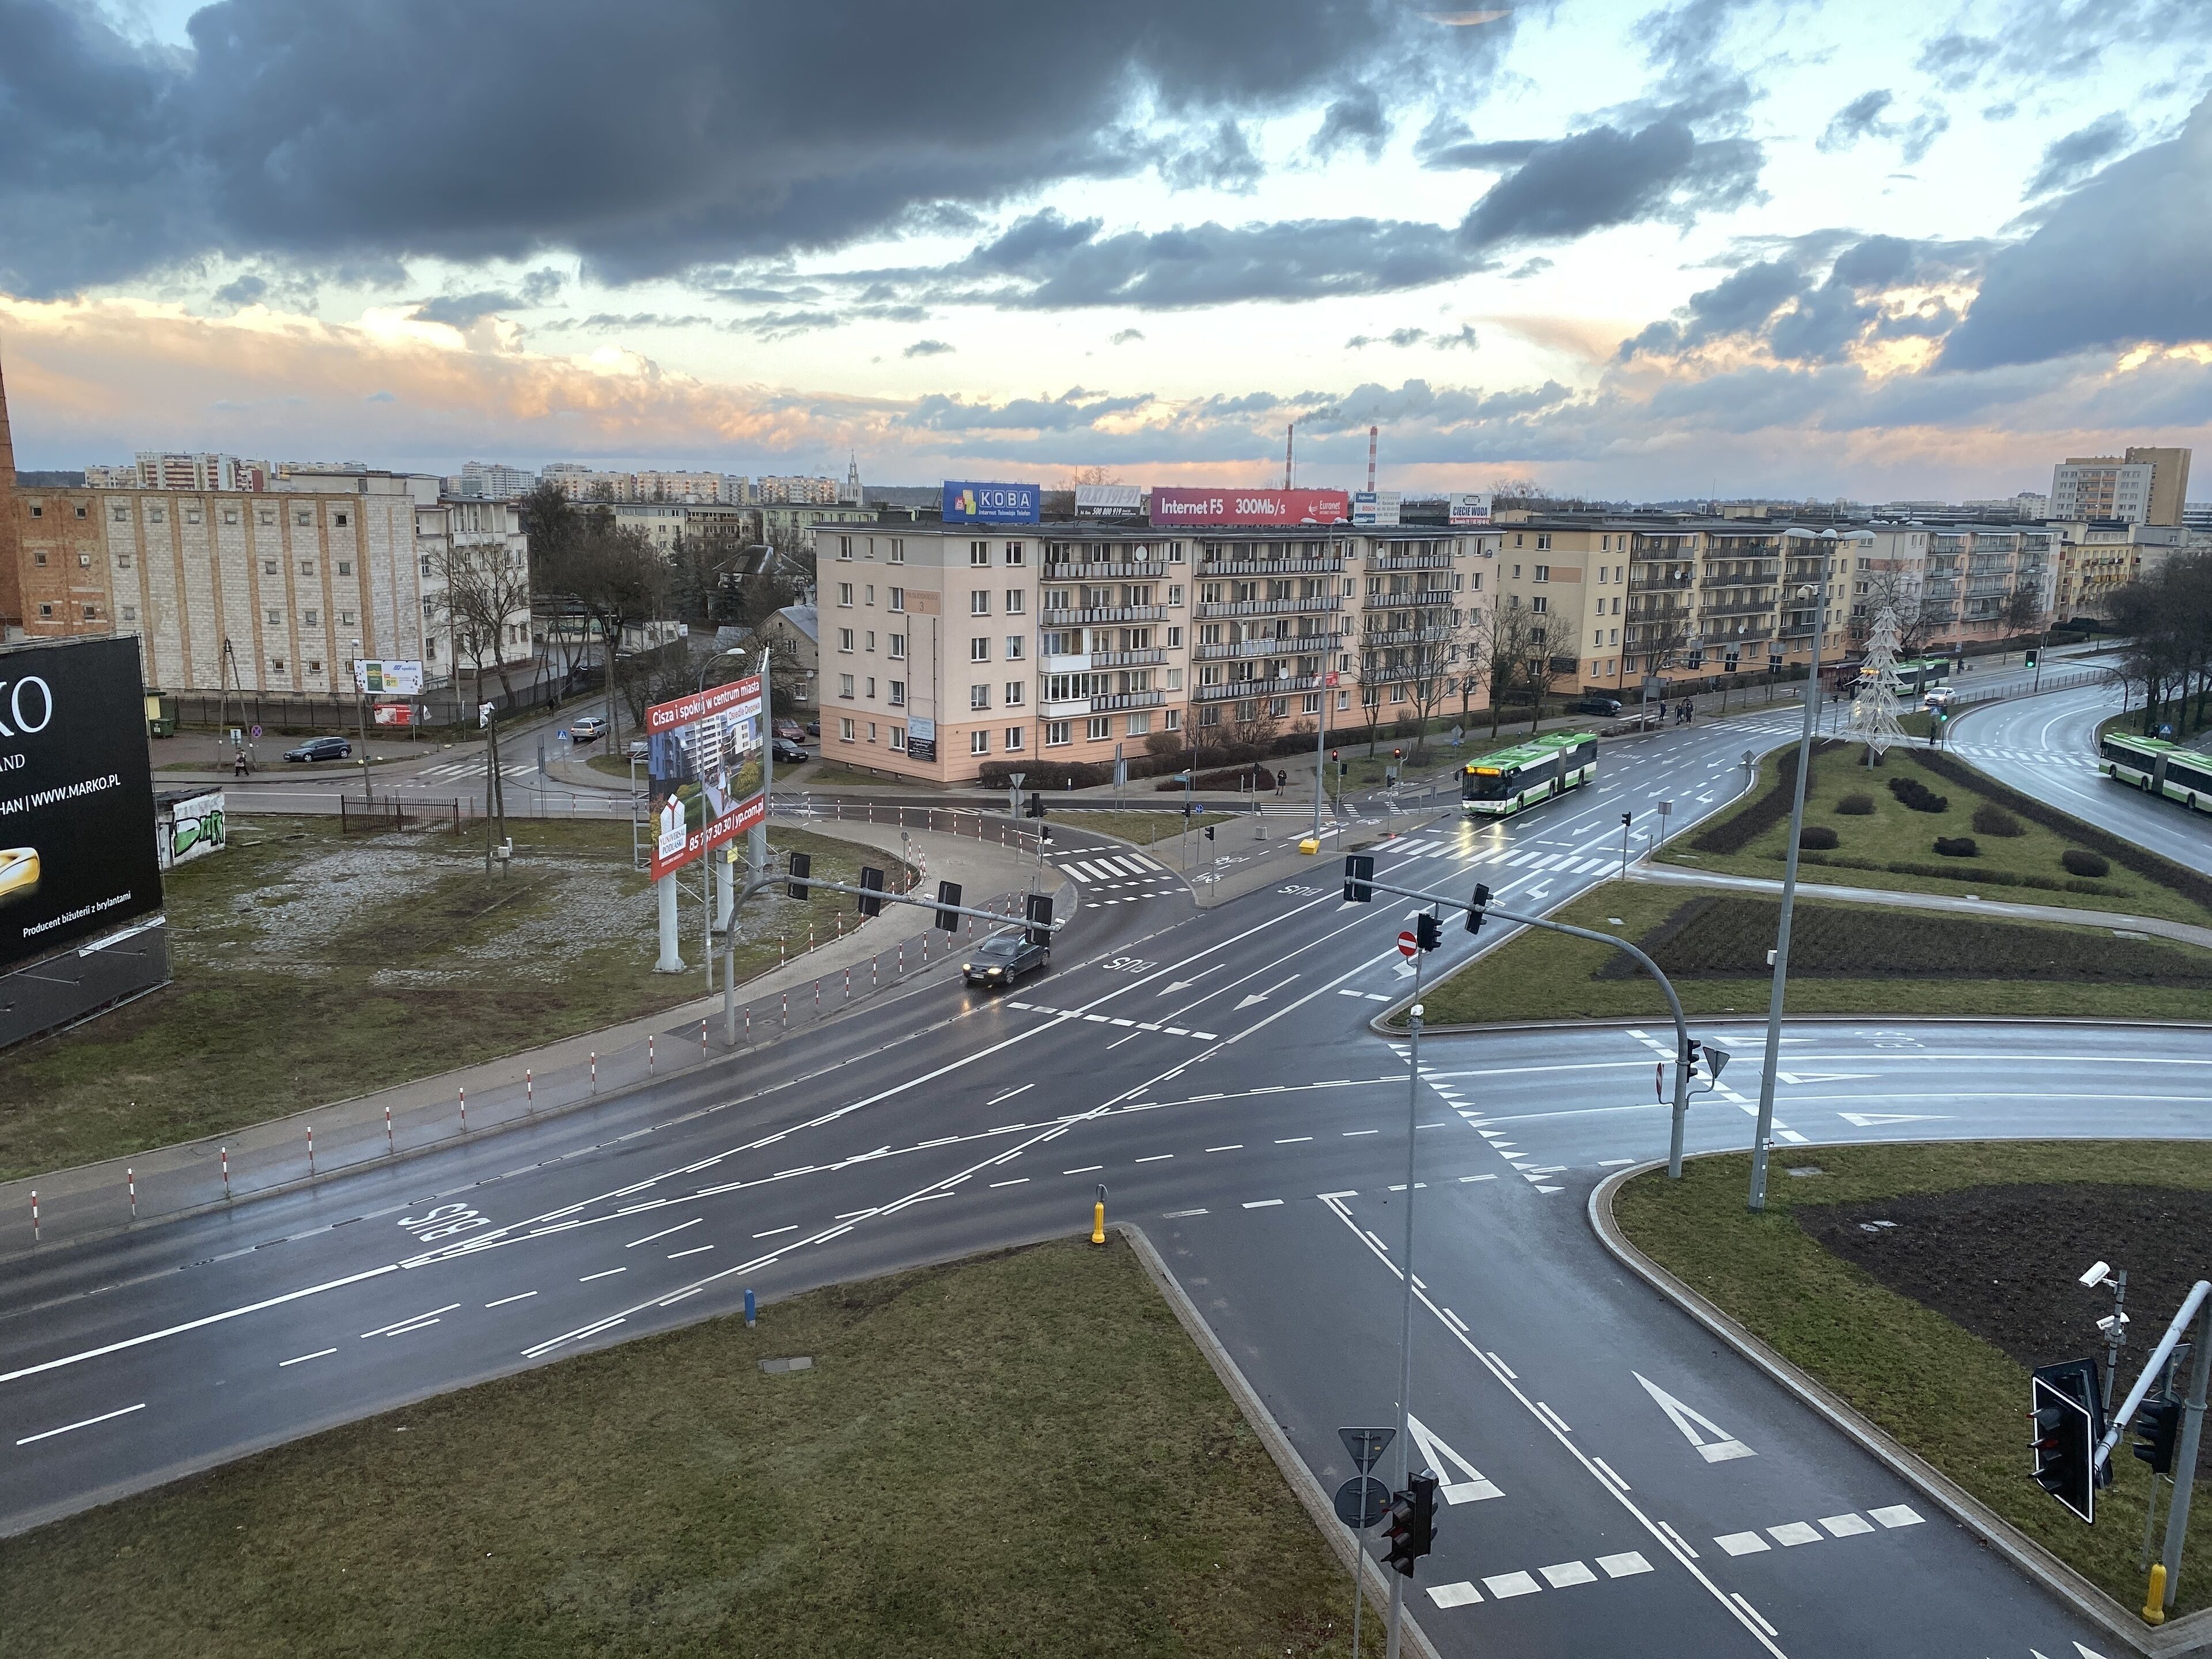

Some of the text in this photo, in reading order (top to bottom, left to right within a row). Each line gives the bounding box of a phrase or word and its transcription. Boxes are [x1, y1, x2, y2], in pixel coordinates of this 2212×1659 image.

[980, 491, 1030, 507] KOBA
[1078, 487, 1104, 503] TAXI
[1092, 507, 1102, 516] 500
[1102, 507, 1112, 516] 800
[1112, 507, 1122, 516] 919
[1161, 497, 1224, 515] Internet F5
[1236, 498, 1286, 516] 300Mb/s
[1319, 500, 1341, 510] Euronet
[1453, 506, 1471, 517] CIĘCIE
[919, 601, 924, 611] 3
[652, 680, 760, 726] Cisza i spokój w centrum miasta
[729, 707, 744, 721] Osiedle
[31, 774, 121, 807] WWW.MARKO.PL
[689, 834, 699, 851] 85
[713, 822, 722, 839] 30
[722, 816, 732, 833] 30
[734, 797, 764, 830] yp.com.pl
[662, 838, 683, 855] PODLASKI
[1277, 885, 1324, 896] BUS
[23, 916, 61, 938] Producent
[61, 905, 90, 923] biżuterii
[96, 890, 131, 911] brylantami
[1103, 957, 1159, 974] BUS
[397, 1203, 491, 1243] BUS
